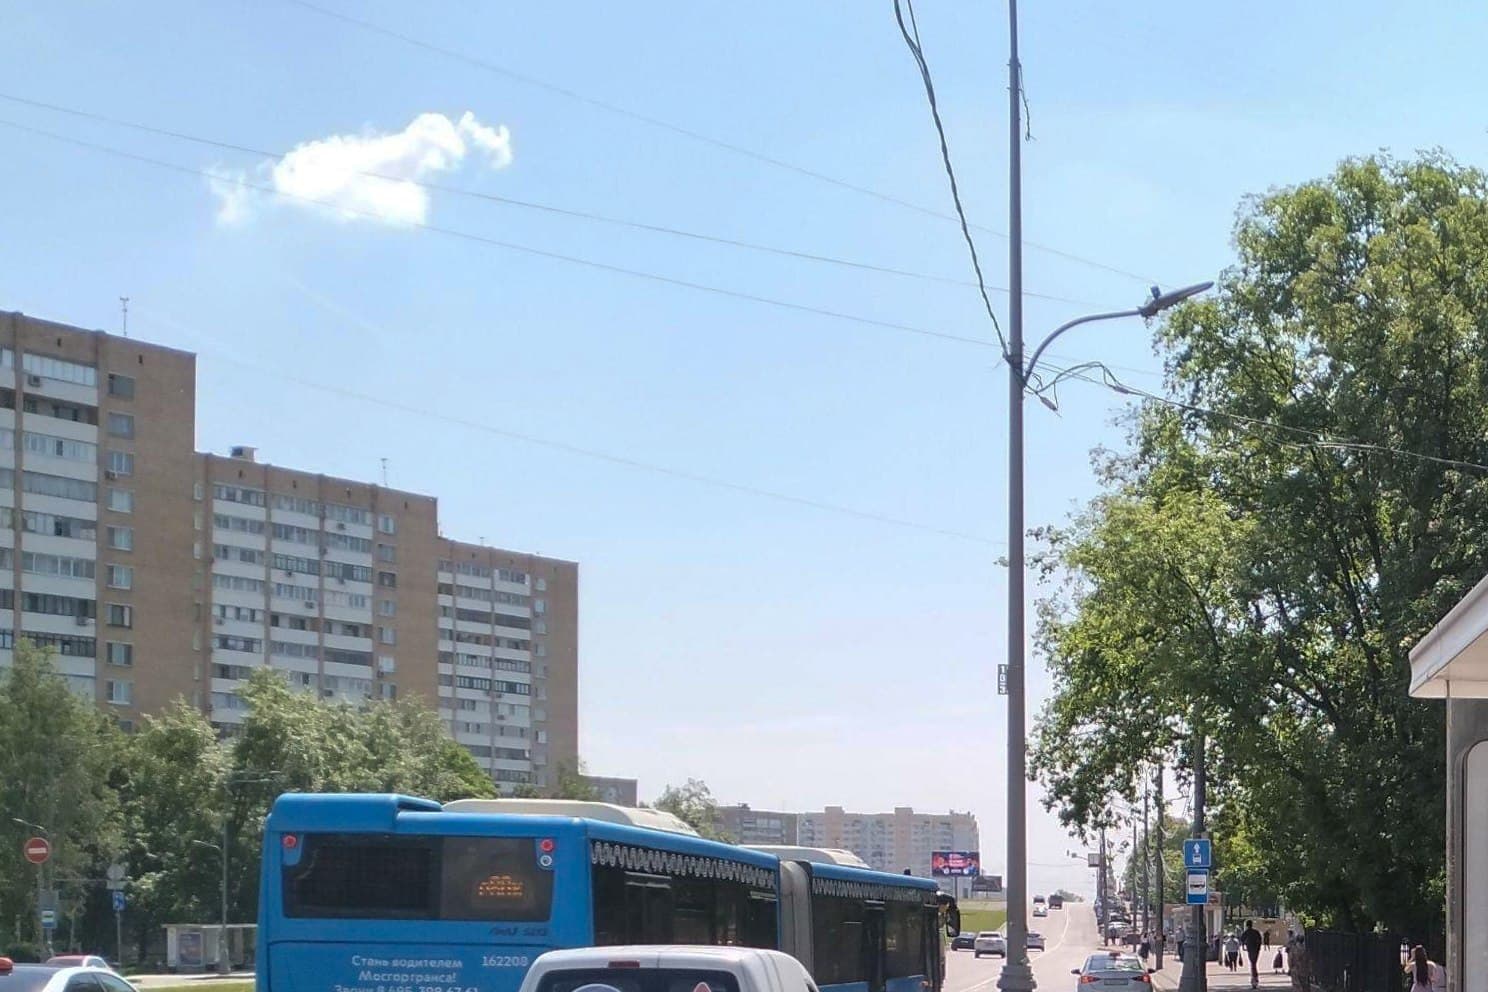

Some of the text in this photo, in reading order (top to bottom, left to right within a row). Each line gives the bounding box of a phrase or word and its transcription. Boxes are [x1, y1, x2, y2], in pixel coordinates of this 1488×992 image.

[351, 955, 463, 969] Стань водителем
[481, 956, 529, 967] 162208
[358, 971, 457, 984] Мосгортранса!
